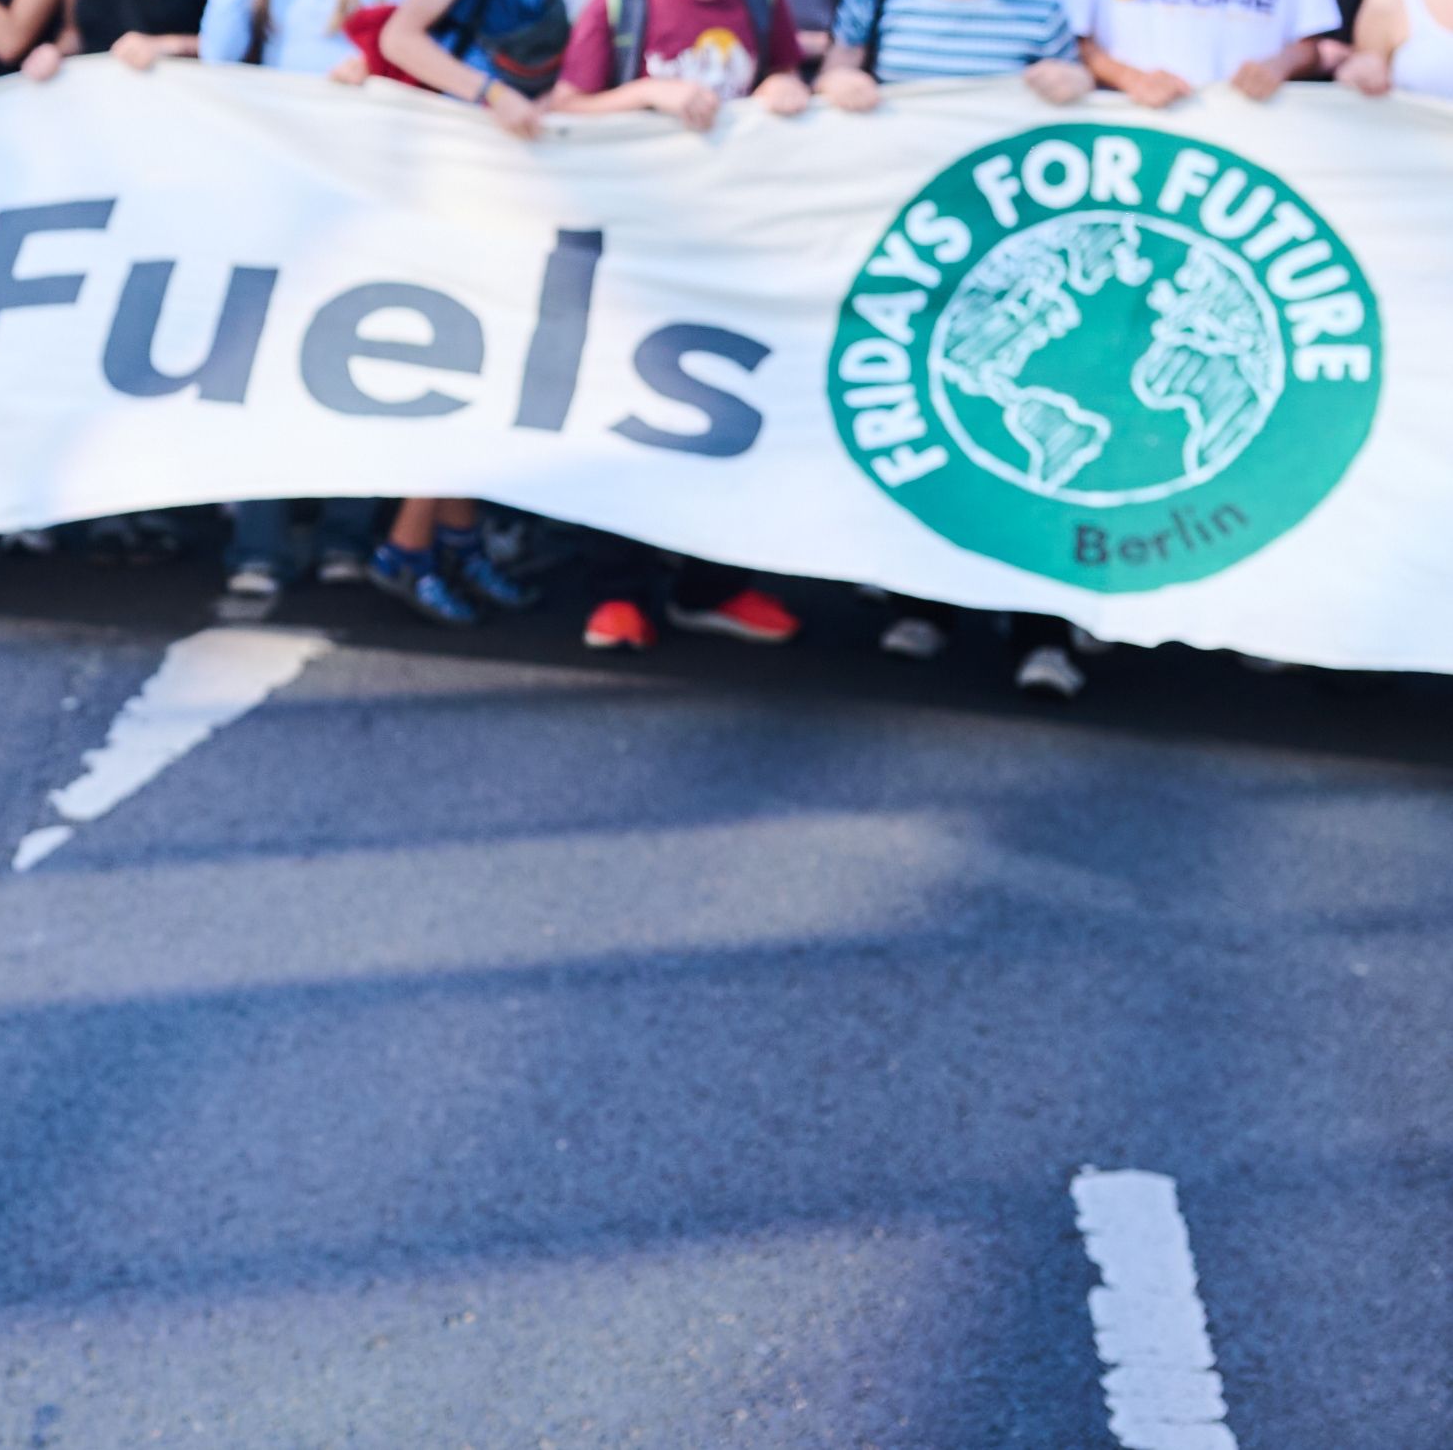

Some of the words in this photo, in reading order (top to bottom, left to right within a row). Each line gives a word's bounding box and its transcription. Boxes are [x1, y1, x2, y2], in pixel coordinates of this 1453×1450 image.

[838, 200, 972, 488] FRIDAYS
[973, 135, 1143, 227] FOR
[1157, 148, 1372, 383] FUTURE
[1072, 501, 1250, 568] Berlin
